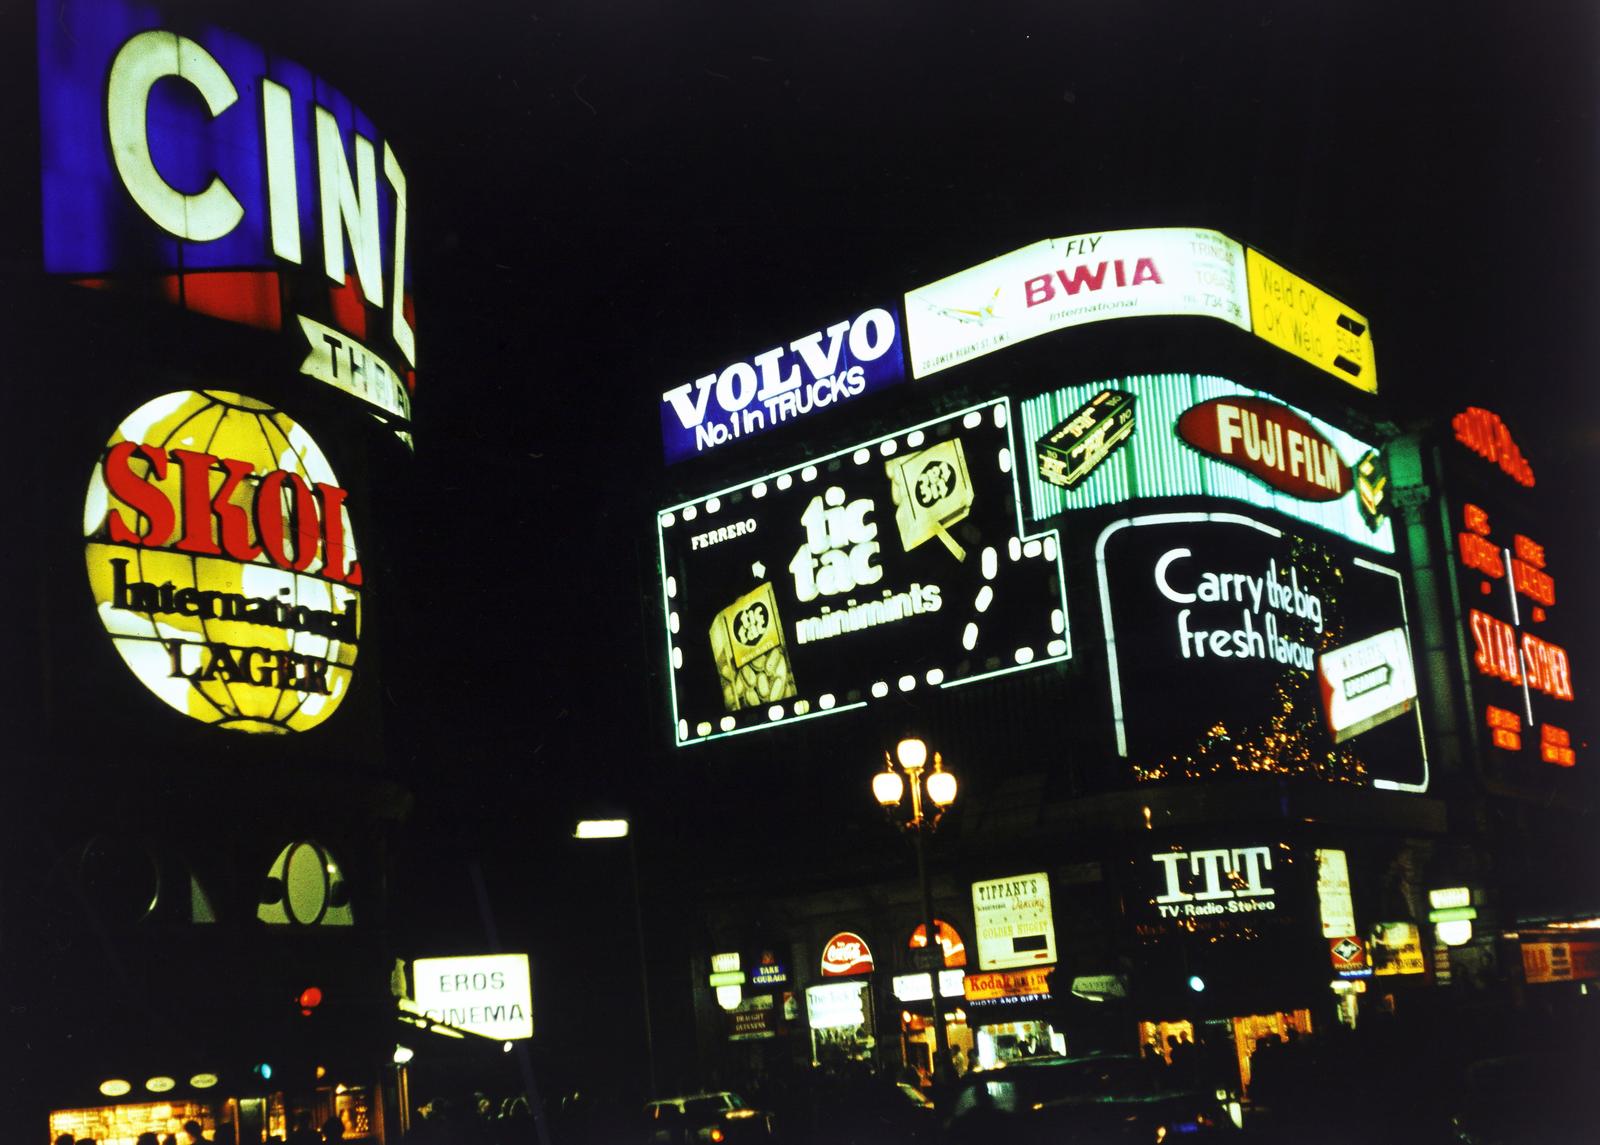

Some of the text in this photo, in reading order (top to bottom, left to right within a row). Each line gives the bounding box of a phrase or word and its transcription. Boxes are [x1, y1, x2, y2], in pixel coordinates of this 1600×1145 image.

[107, 29, 416, 370] CINZ
[1065, 236, 1102, 257] FLY
[1024, 257, 1164, 309] BWIA
[1259, 263, 1294, 308] Weld
[662, 308, 895, 429] VOLVO
[695, 411, 740, 451] No.1
[763, 365, 866, 425] TRUCKS
[1216, 403, 1342, 494] FUJI FILM
[104, 440, 363, 586] SKOL
[691, 517, 757, 551] FERRERO
[800, 485, 878, 555] tic
[788, 541, 883, 602] tac
[1154, 547, 1324, 634] Carry the big
[737, 622, 767, 645] tac
[740, 605, 766, 629] tic
[1177, 608, 1266, 659] fresh
[1265, 611, 1316, 672] flavour
[167, 638, 333, 696] LAGER
[978, 879, 1039, 901] TIFFANY'S
[1152, 846, 1275, 904] ITT
[439, 971, 505, 993] EROS
[752, 974, 787, 985] COURAGE
[759, 965, 779, 976] TAKE
[970, 974, 1012, 992] Kodak
[425, 1004, 524, 1026] CINEMA
[1000, 996, 1018, 1005] AND
[1020, 993, 1040, 1002] GIFT
